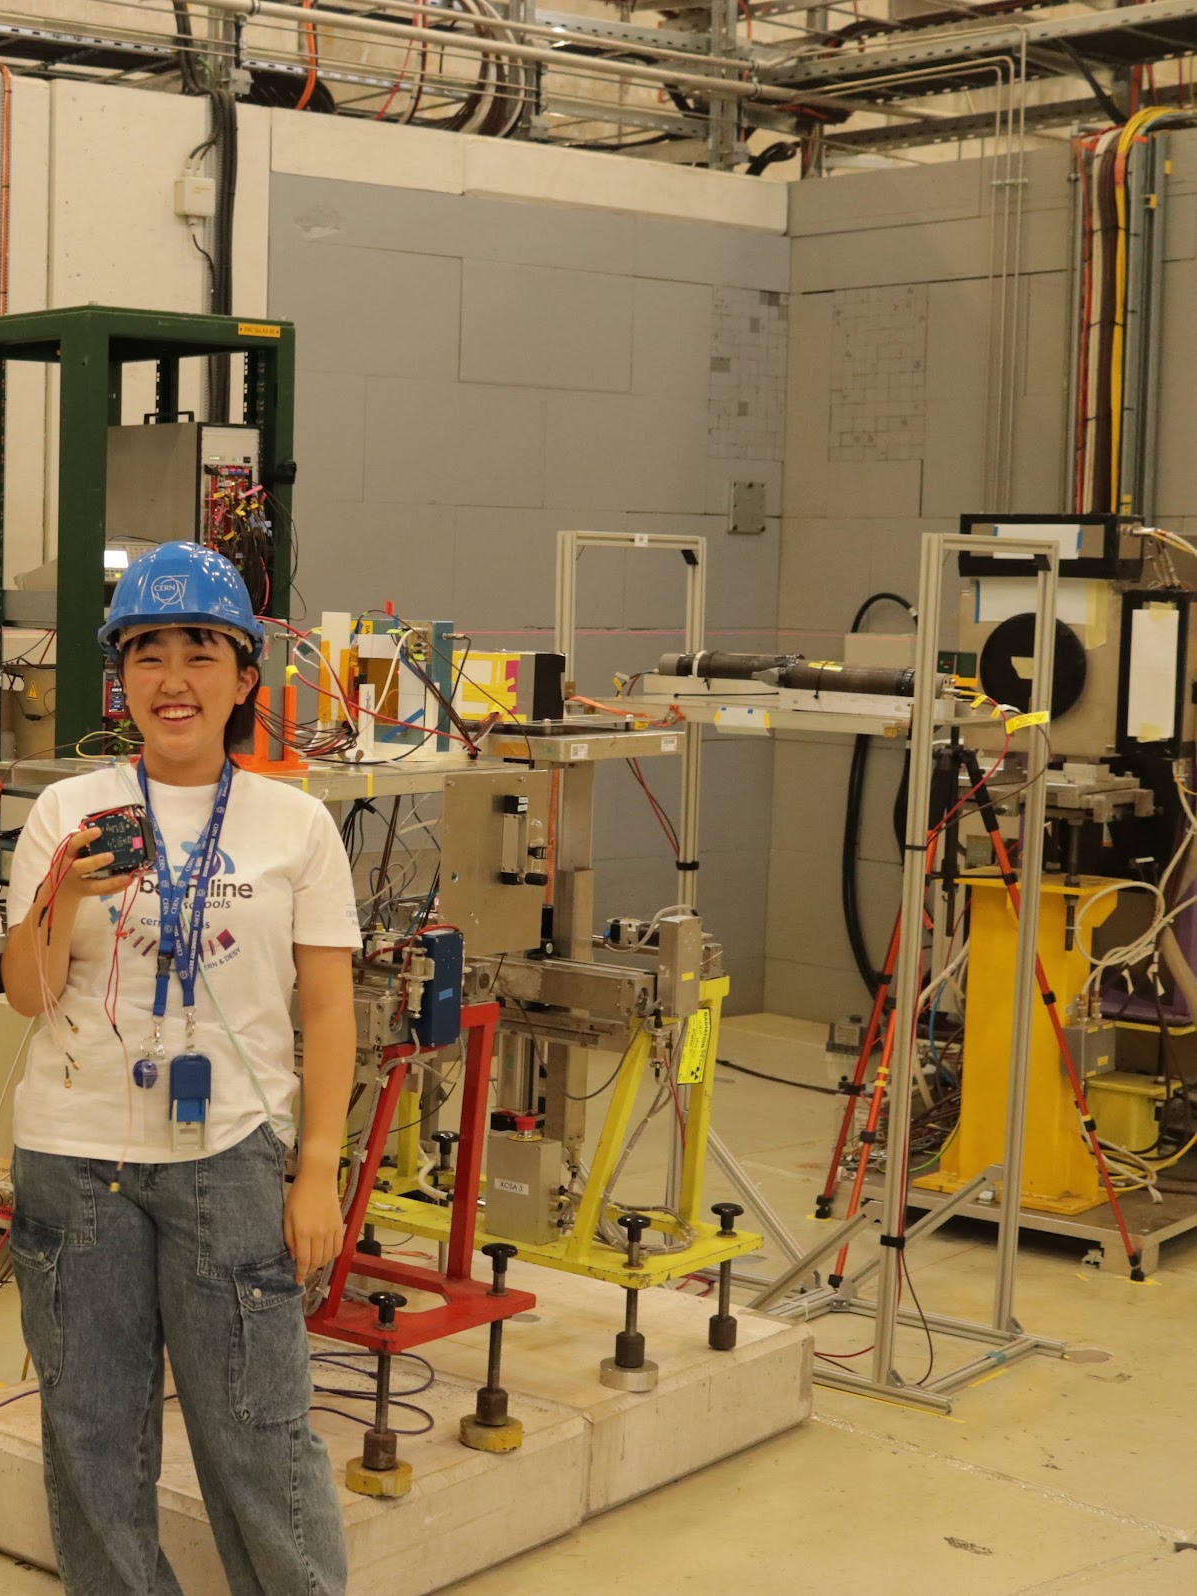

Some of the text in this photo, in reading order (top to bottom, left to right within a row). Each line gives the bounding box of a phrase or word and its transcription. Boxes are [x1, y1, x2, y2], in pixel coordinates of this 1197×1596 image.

[158, 855, 166, 871] CERN
[139, 876, 253, 899] bmline
[170, 897, 180, 914] CERN
[183, 898, 231, 910] scools
[225, 947, 241, 962] DESY
[701, 1012, 709, 1048] RADIATION
